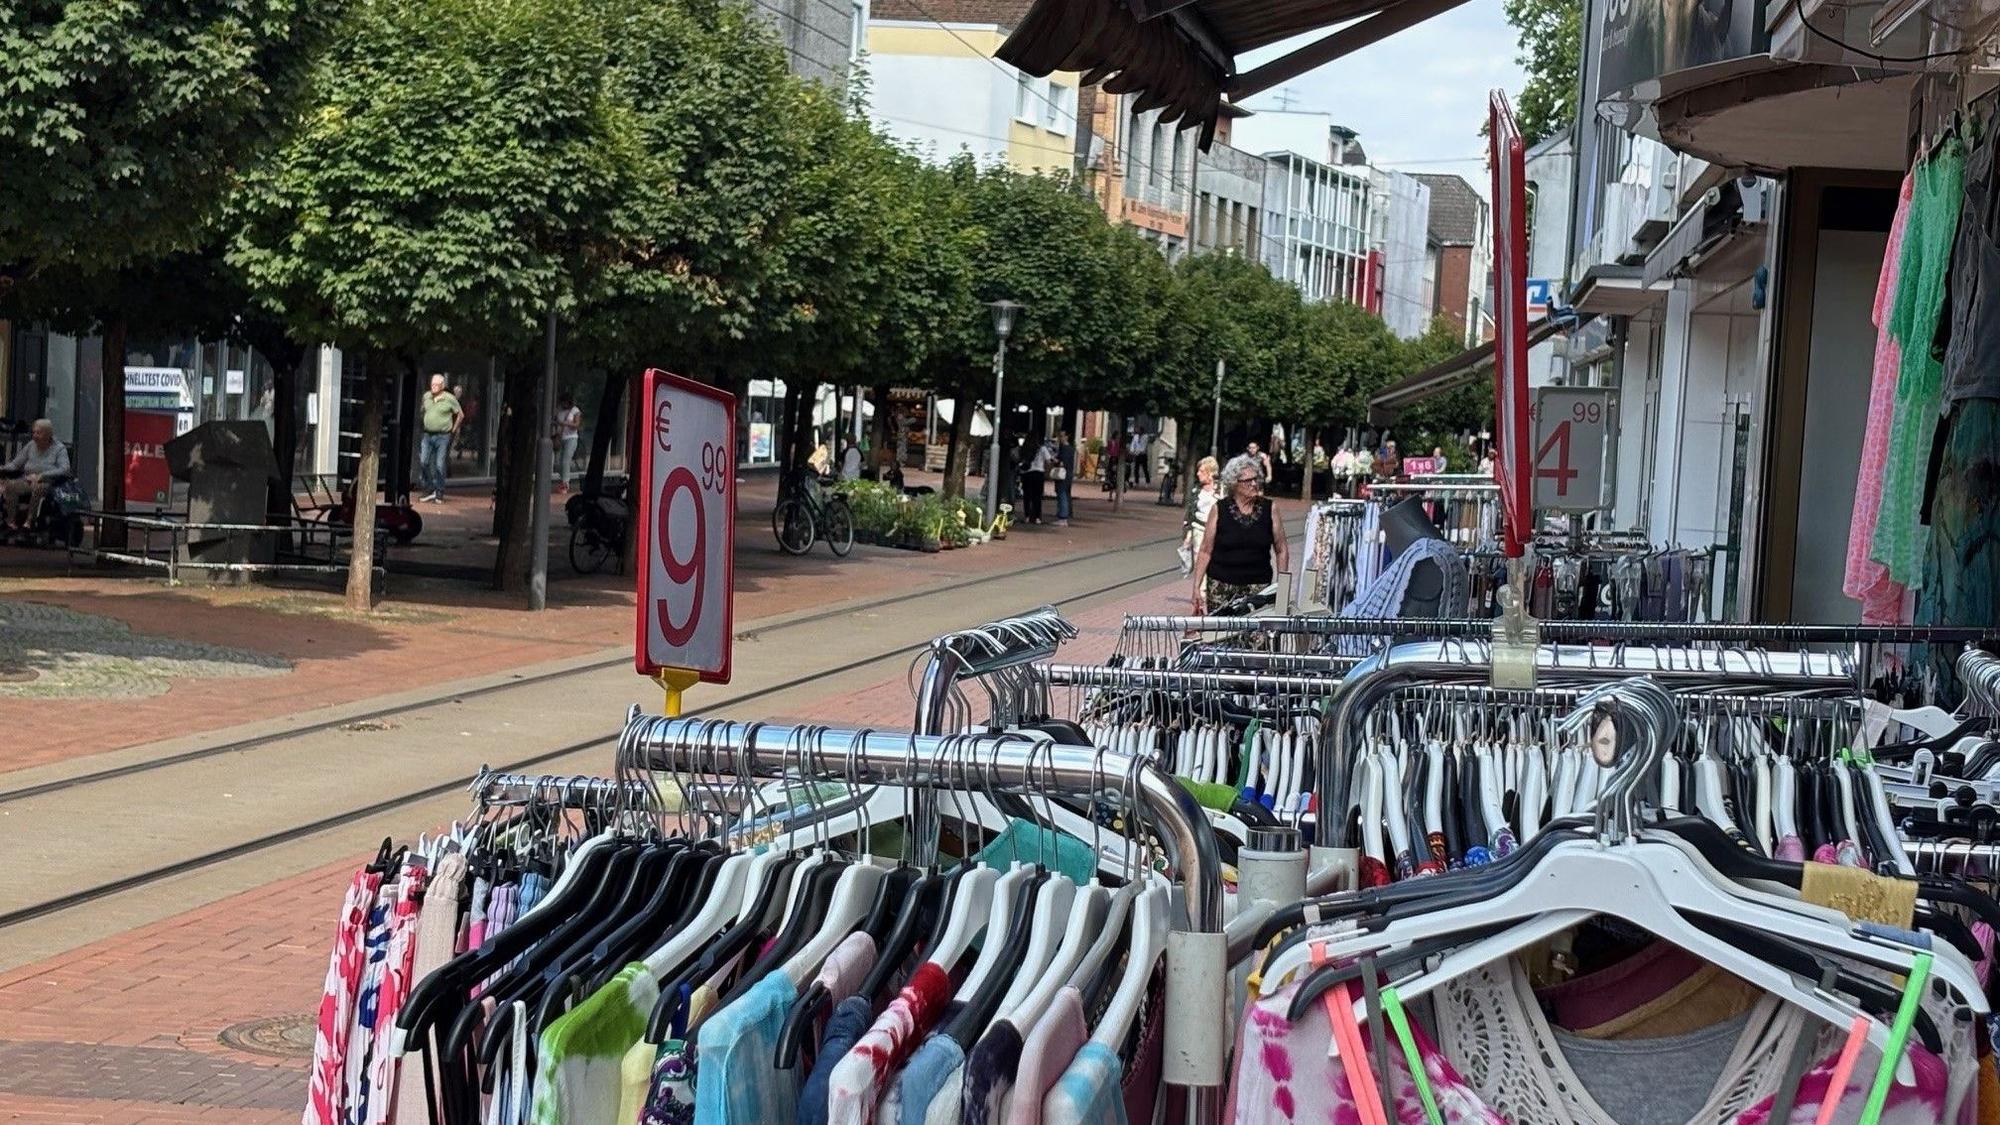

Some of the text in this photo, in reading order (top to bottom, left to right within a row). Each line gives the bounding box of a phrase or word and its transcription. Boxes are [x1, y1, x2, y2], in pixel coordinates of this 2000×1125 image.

[125, 373, 160, 386] HNELLTEST
[124, 441, 165, 459] SALE
[1530, 420, 1578, 496] 4
[1573, 402, 1601, 423] 99
[656, 400, 727, 647] € 9 99
